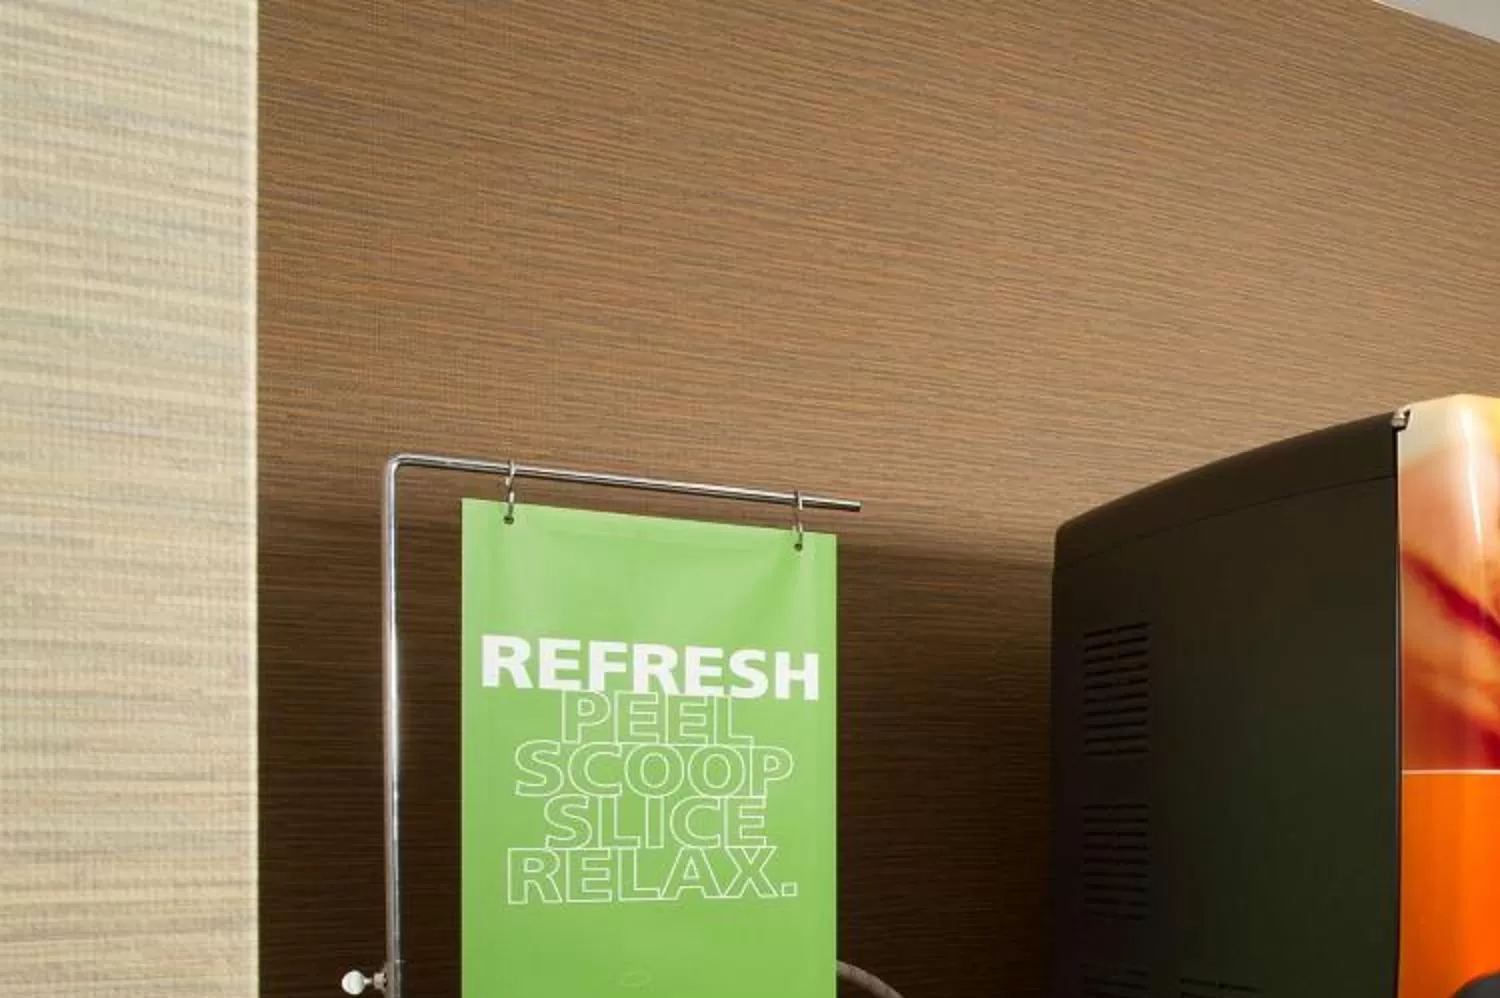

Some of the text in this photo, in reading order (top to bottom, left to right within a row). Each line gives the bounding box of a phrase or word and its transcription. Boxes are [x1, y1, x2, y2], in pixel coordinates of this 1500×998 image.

[481, 634, 820, 701] REFRESH
[561, 689, 755, 745] PEEL
[514, 740, 794, 798] SCOOP
[543, 793, 768, 849] SLICE
[507, 845, 798, 904] RELAX.
